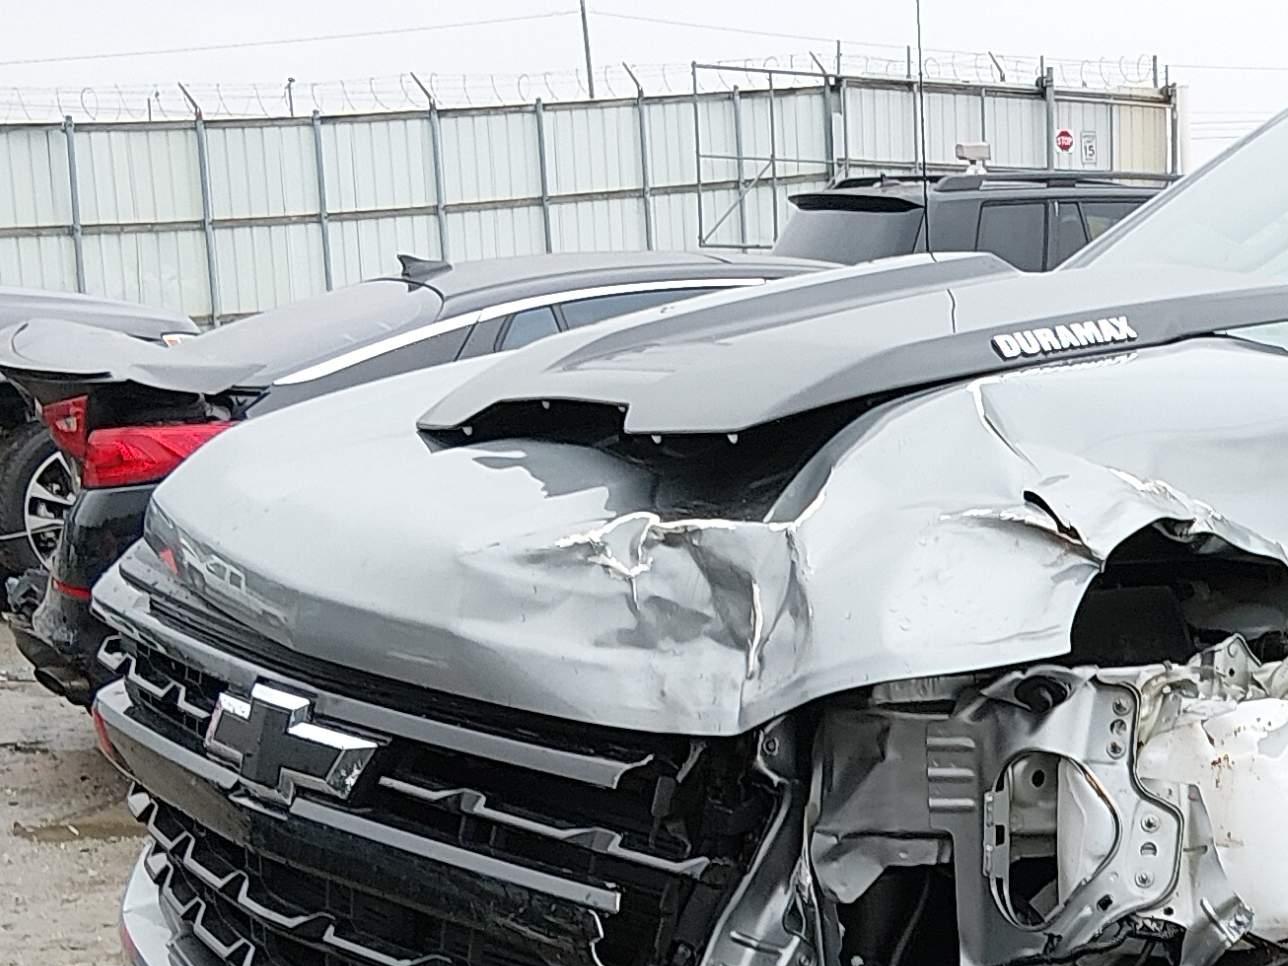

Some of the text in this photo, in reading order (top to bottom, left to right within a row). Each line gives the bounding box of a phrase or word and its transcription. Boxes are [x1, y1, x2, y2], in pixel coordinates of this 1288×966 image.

[1057, 136, 1073, 146] STOP
[1084, 145, 1095, 157] 15
[992, 315, 1138, 358] DURAMAX
